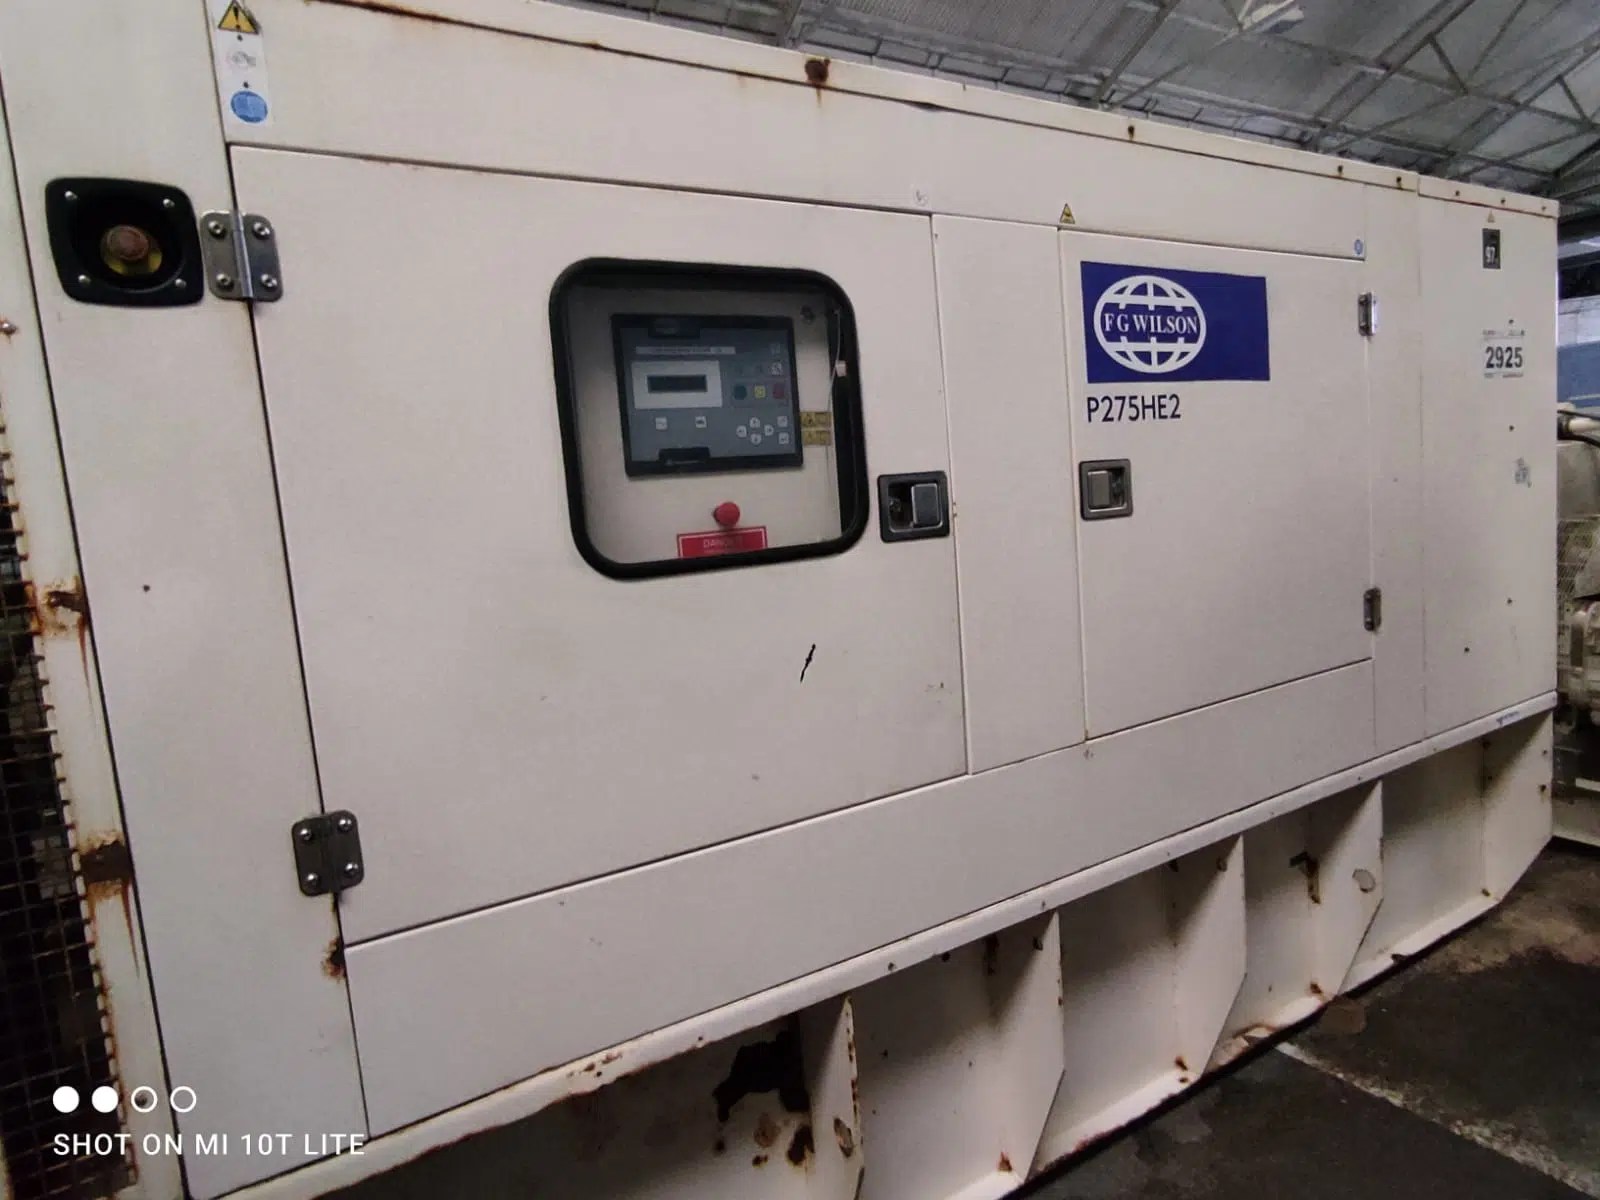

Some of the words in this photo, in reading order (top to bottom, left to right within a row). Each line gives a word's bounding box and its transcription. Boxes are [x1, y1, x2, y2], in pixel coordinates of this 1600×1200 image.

[1132, 313, 1198, 334] WILSON
[1485, 346, 1523, 369] 2925
[1086, 394, 1181, 423] P275HE2
